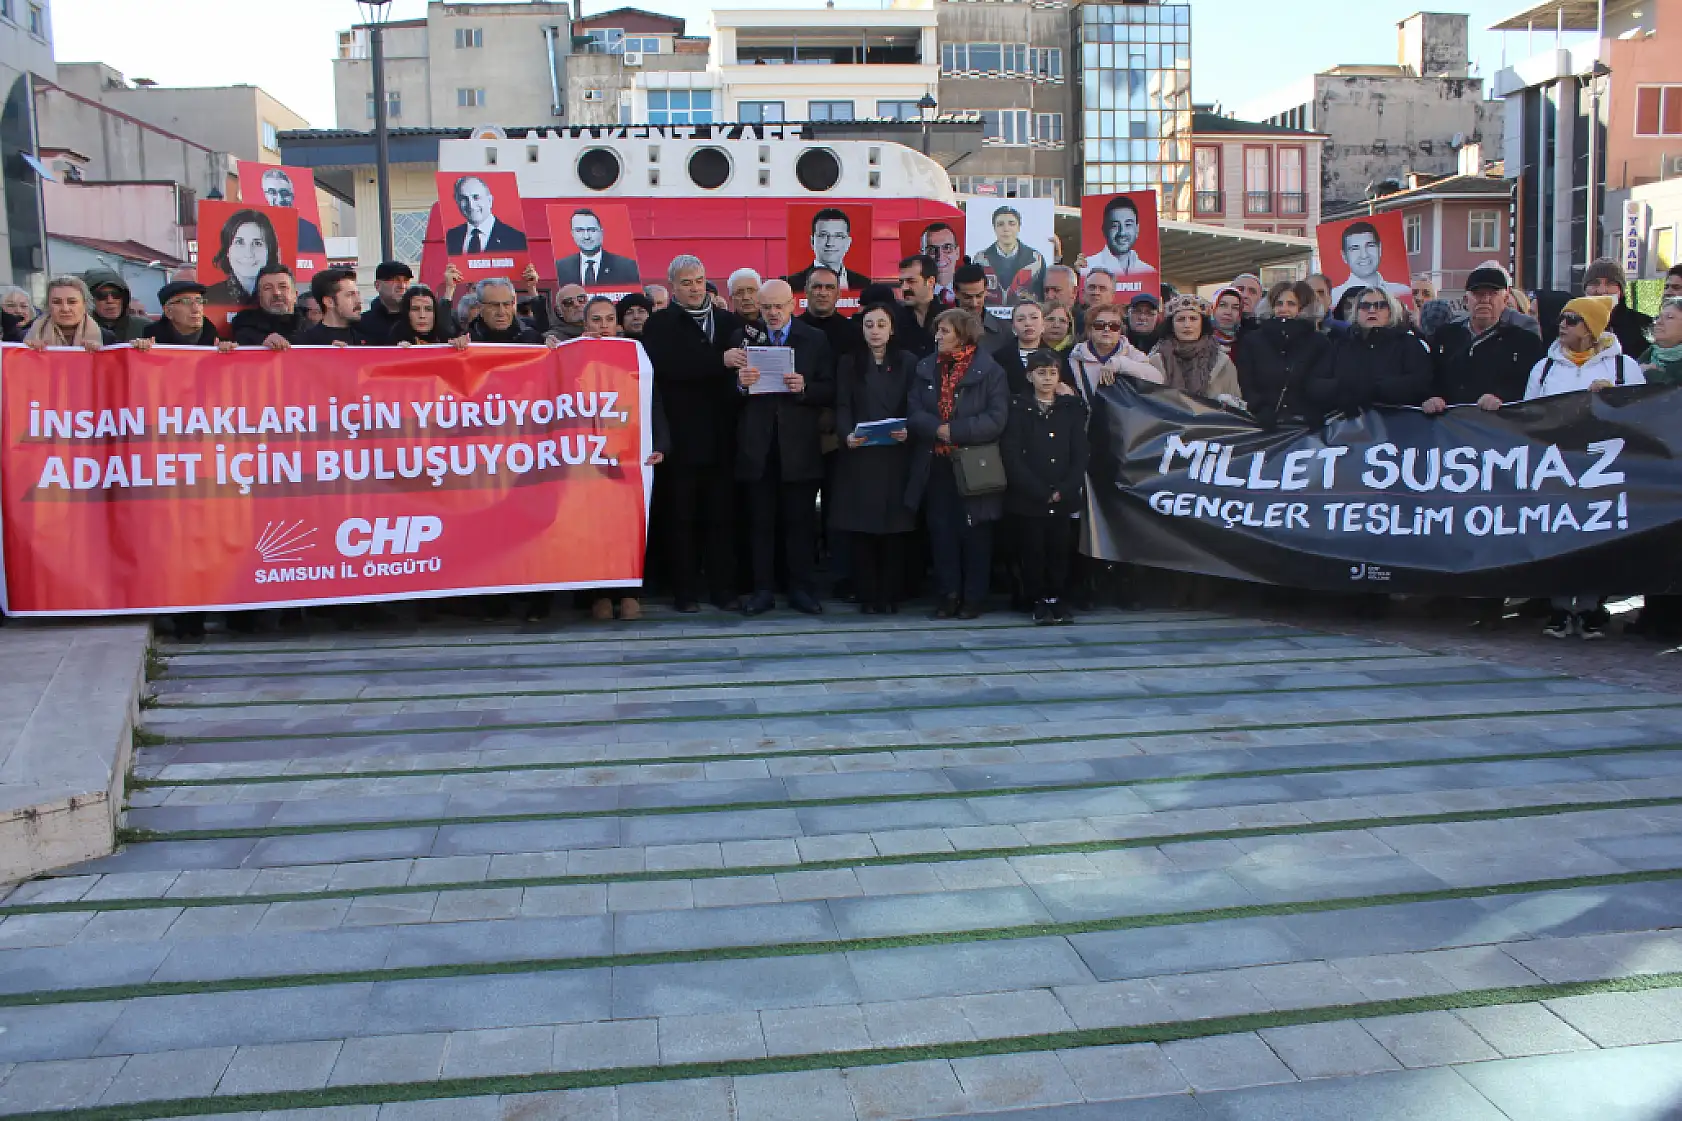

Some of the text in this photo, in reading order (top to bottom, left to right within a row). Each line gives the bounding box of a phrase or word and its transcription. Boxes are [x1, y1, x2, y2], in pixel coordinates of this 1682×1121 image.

[1627, 216, 1638, 271] YABAN
[30, 391, 628, 439] İNSAN HAKLARI İÇİN YÜRÜYORUZ,
[38, 434, 618, 494] ADALET İÇİN BULUŞUYORUZ.
[1361, 437, 1626, 493] SUSMAZ
[335, 515, 443, 557] CHP
[1149, 491, 1310, 529] GENÇLER
[1464, 491, 1628, 537] OLMAZ!
[255, 556, 442, 583] SAMSUN İL ÖRGÜTÜ
